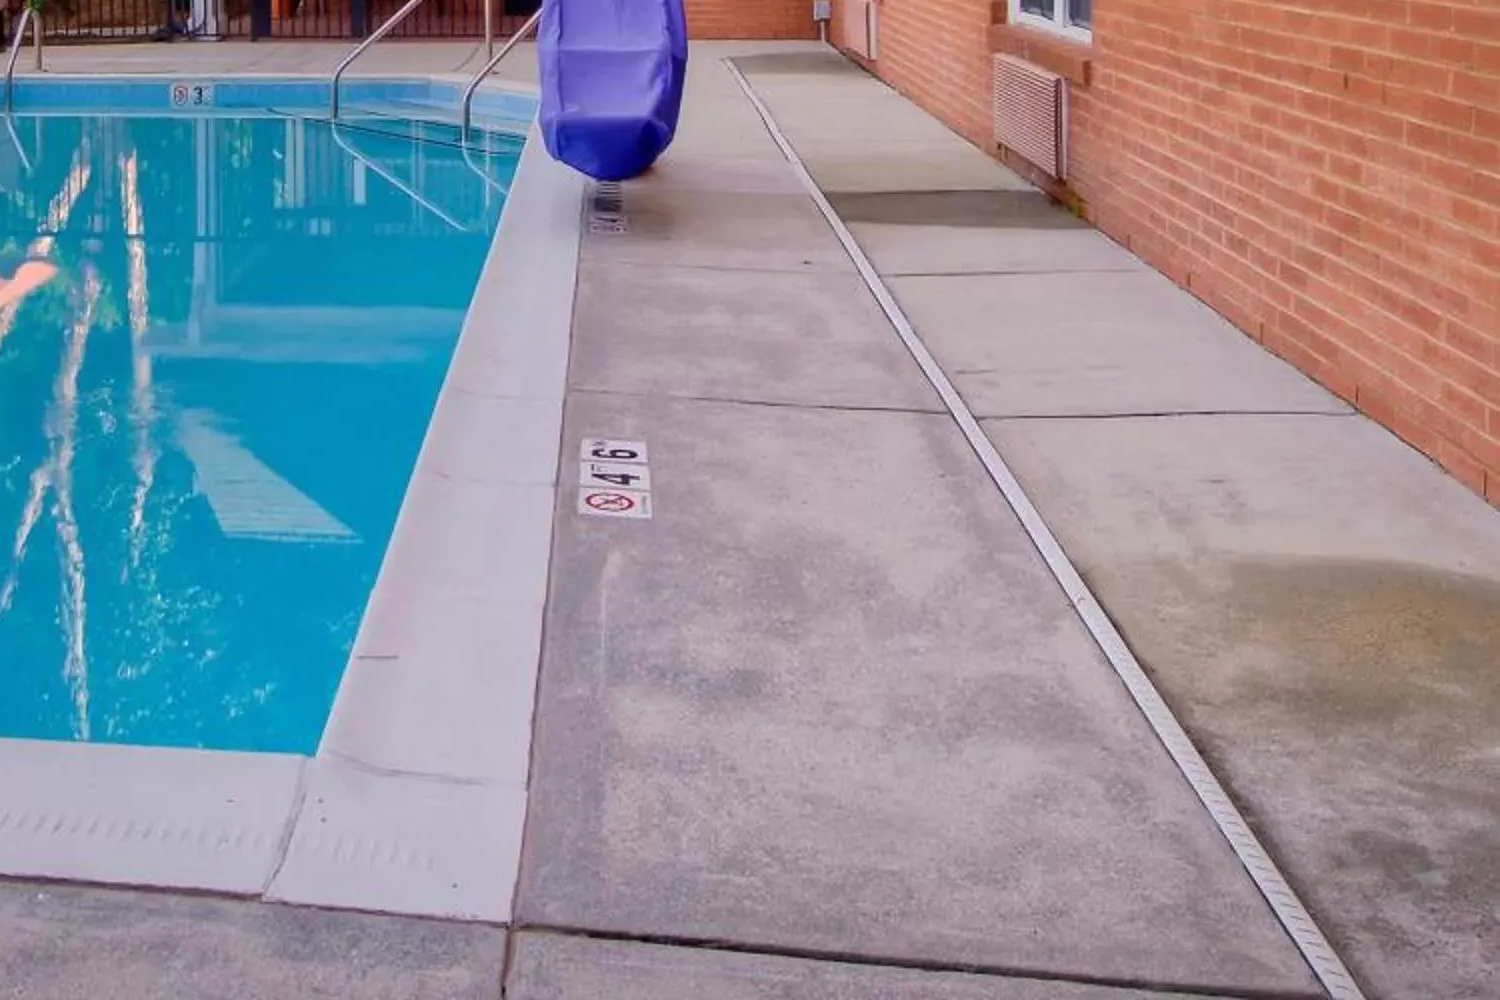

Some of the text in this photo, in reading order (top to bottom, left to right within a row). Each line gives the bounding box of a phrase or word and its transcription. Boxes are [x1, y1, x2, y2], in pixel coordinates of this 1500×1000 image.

[193, 85, 203, 105] 3
[591, 448, 638, 459] 6
[591, 473, 641, 486] 4
